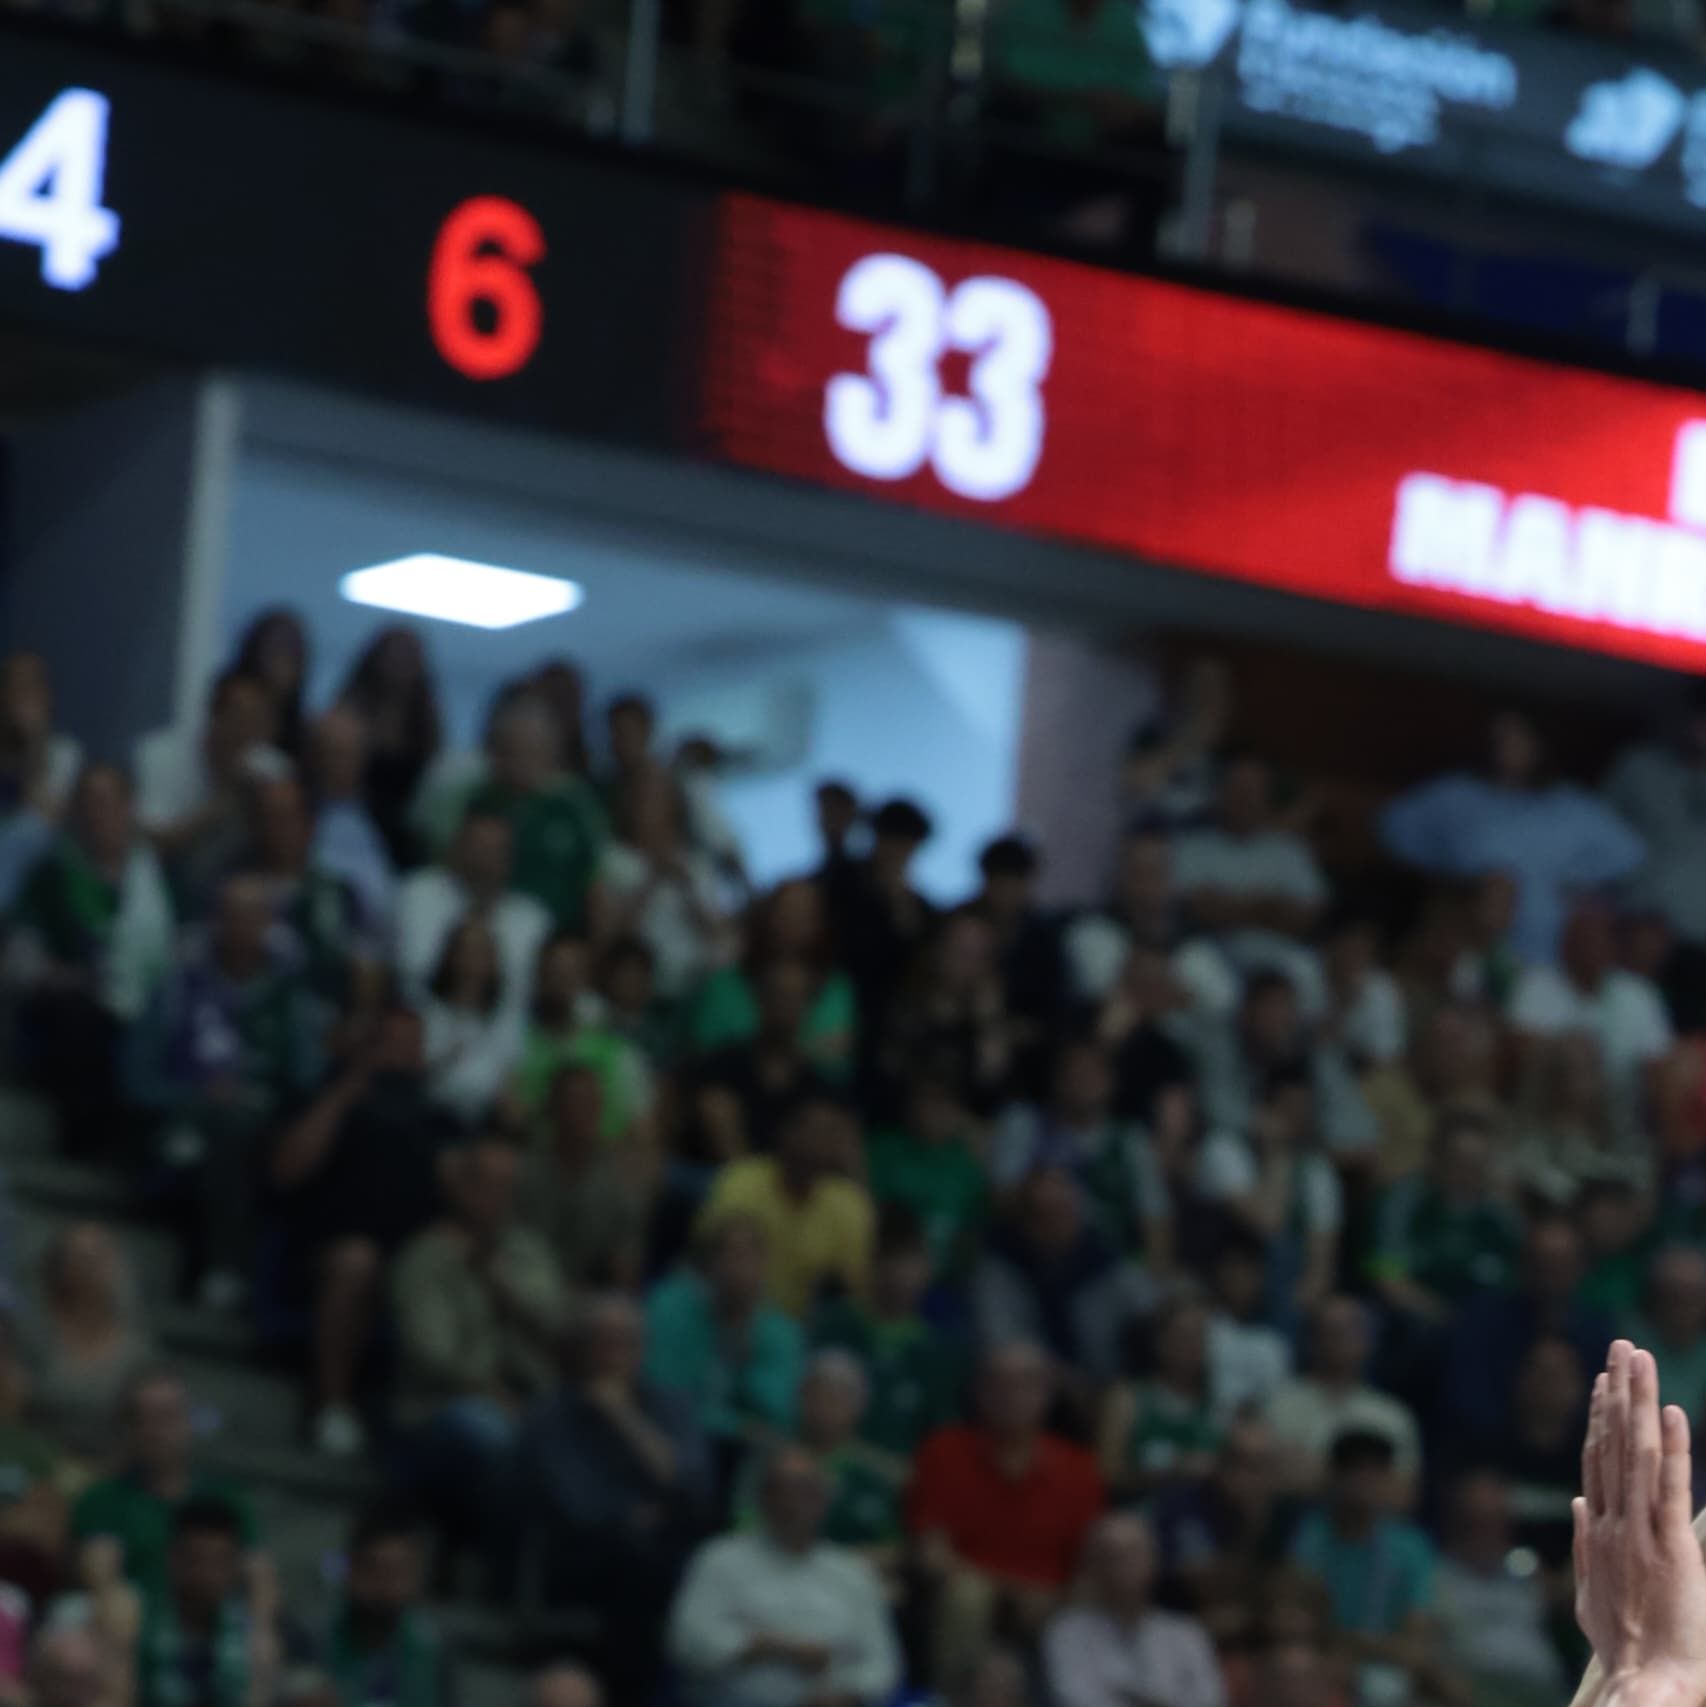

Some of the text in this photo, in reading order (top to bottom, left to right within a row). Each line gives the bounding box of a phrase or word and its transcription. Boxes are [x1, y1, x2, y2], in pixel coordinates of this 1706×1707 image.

[0, 88, 1052, 502] 4 6 33
